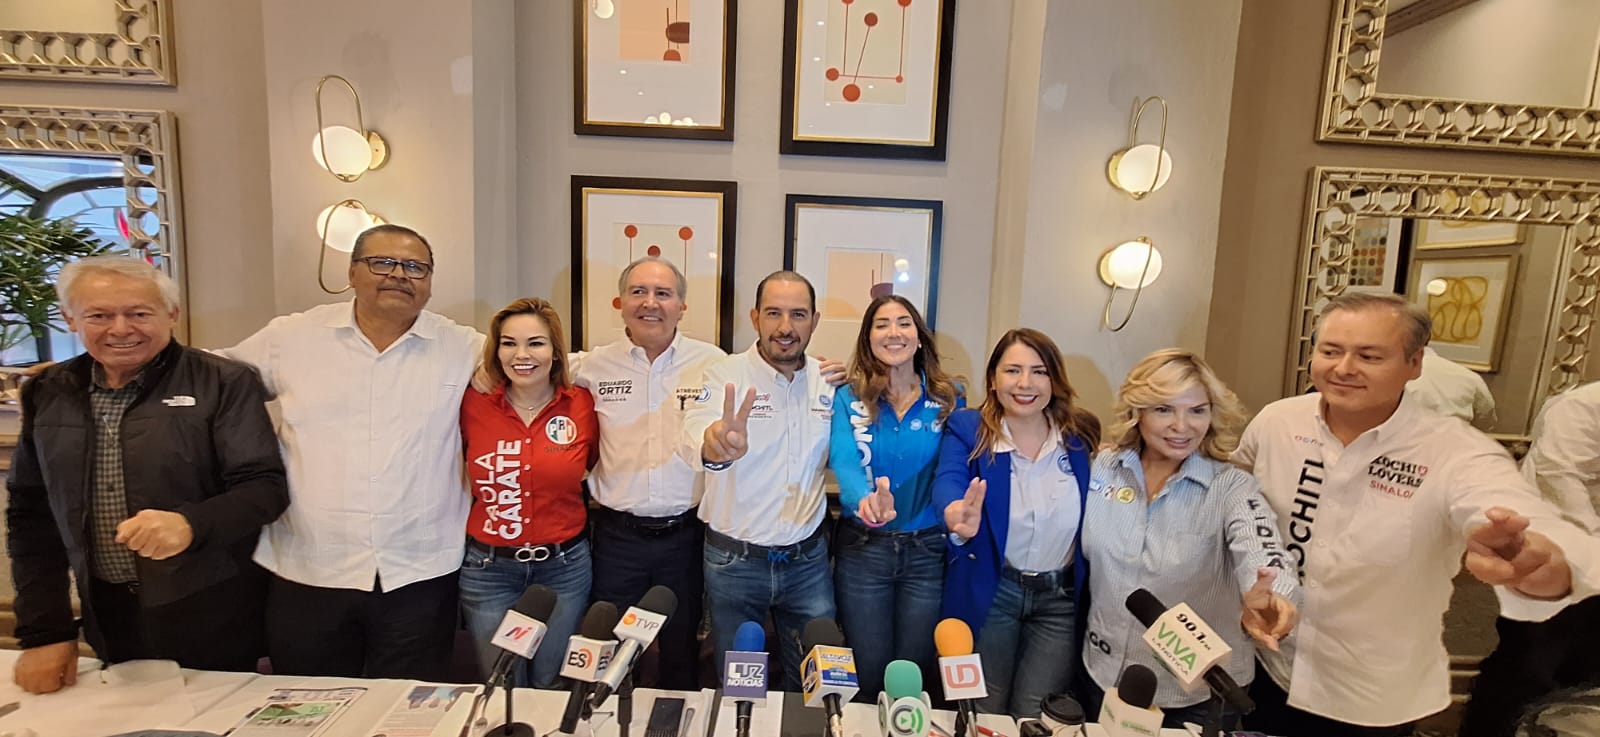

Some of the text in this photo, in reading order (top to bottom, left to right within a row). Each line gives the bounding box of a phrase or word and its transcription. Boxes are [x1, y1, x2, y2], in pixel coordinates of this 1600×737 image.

[598, 386, 633, 396] ORTIZ
[474, 451, 500, 535] PAOLA
[496, 439, 523, 540] GARATE
[636, 617, 660, 630] TVP
[1158, 622, 1197, 670] VIVA
[568, 651, 588, 668] ES
[728, 662, 765, 679] LUZ
[727, 678, 764, 687] NOTICIAS
